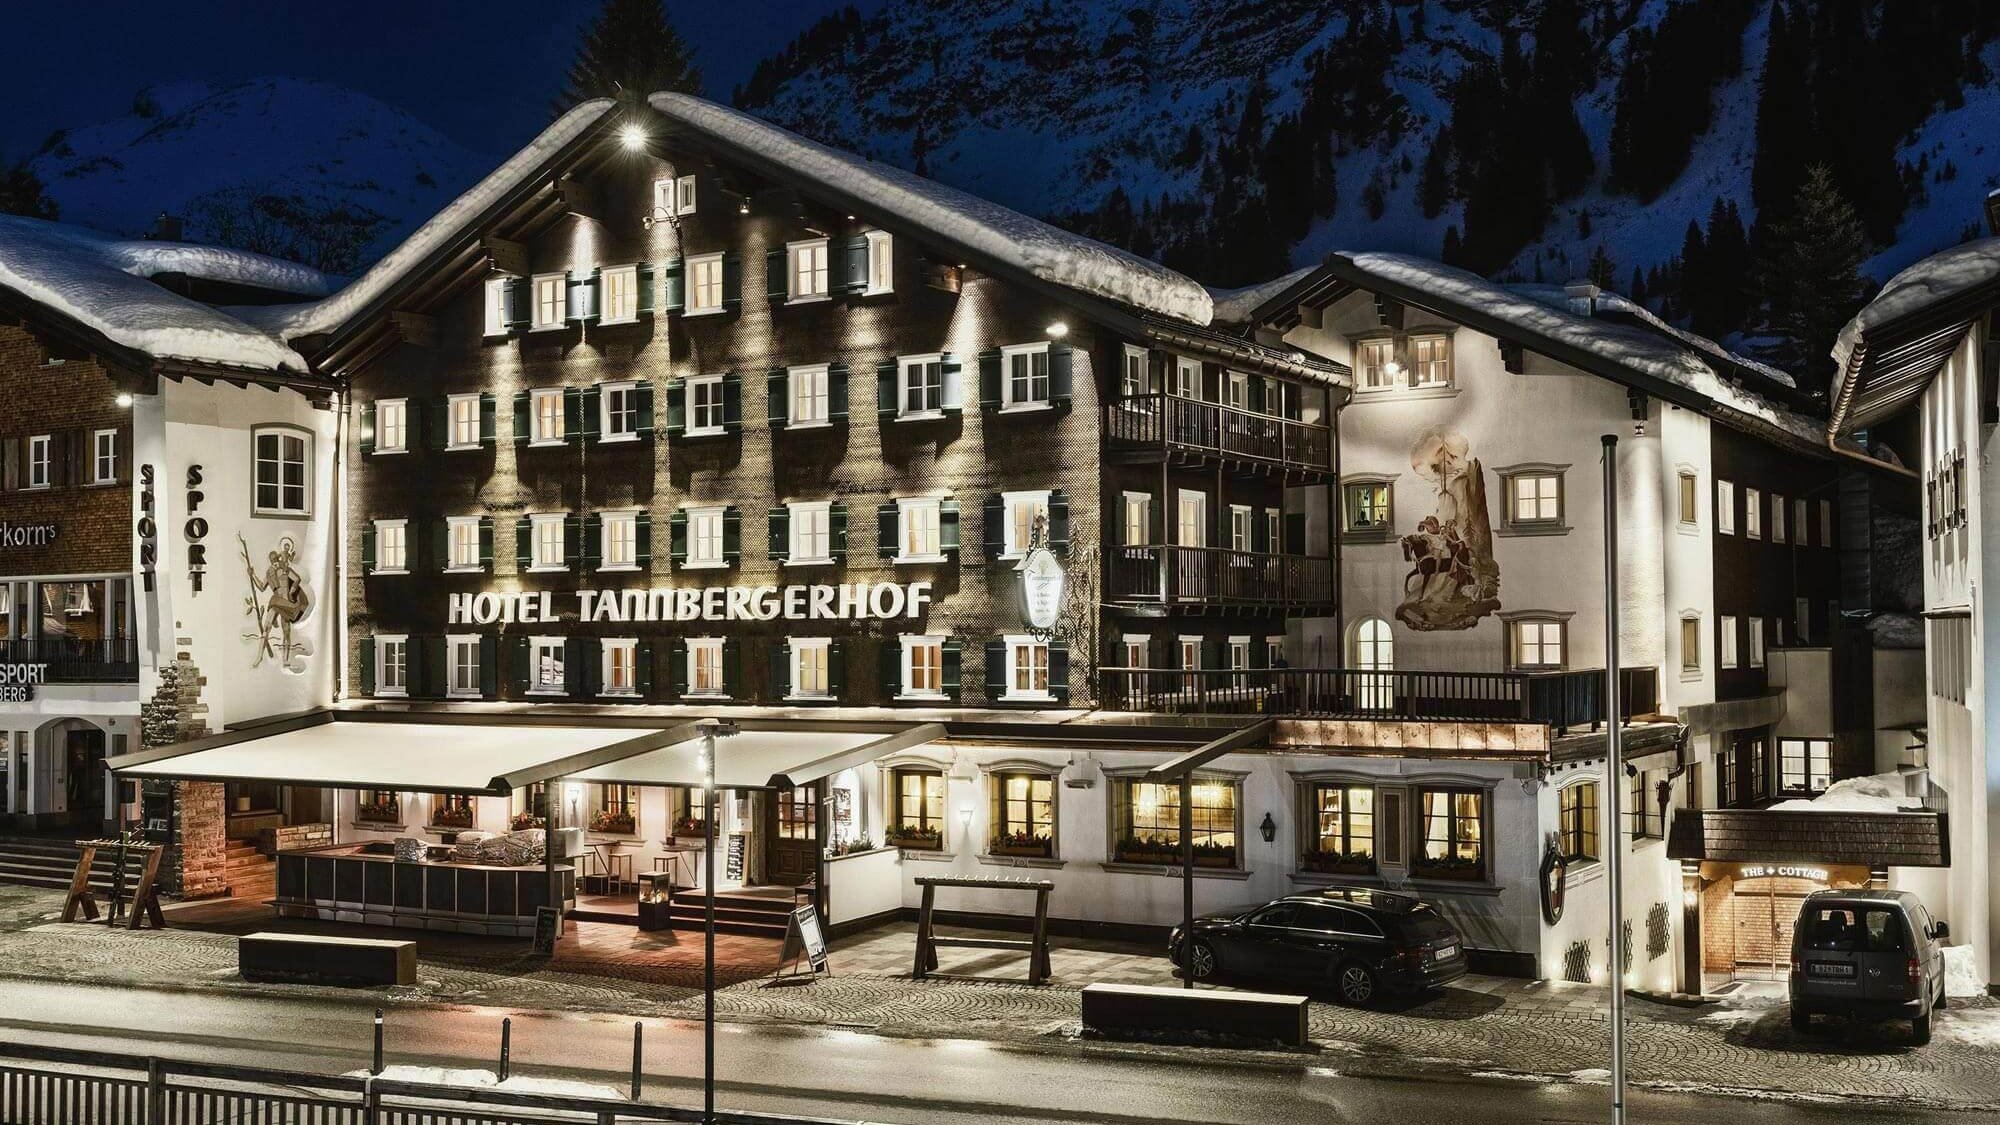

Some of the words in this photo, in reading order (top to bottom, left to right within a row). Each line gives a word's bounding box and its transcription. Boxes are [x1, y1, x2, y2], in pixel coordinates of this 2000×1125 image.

[138, 464, 156, 592] SPORT
[185, 464, 208, 592] SPORT
[448, 591, 560, 624] HOTEL
[576, 582, 932, 623] TANNBERGERHOF
[0, 663, 48, 684] SPORT
[1741, 866, 1764, 877] THE
[1778, 866, 1828, 881] COTTAGE
